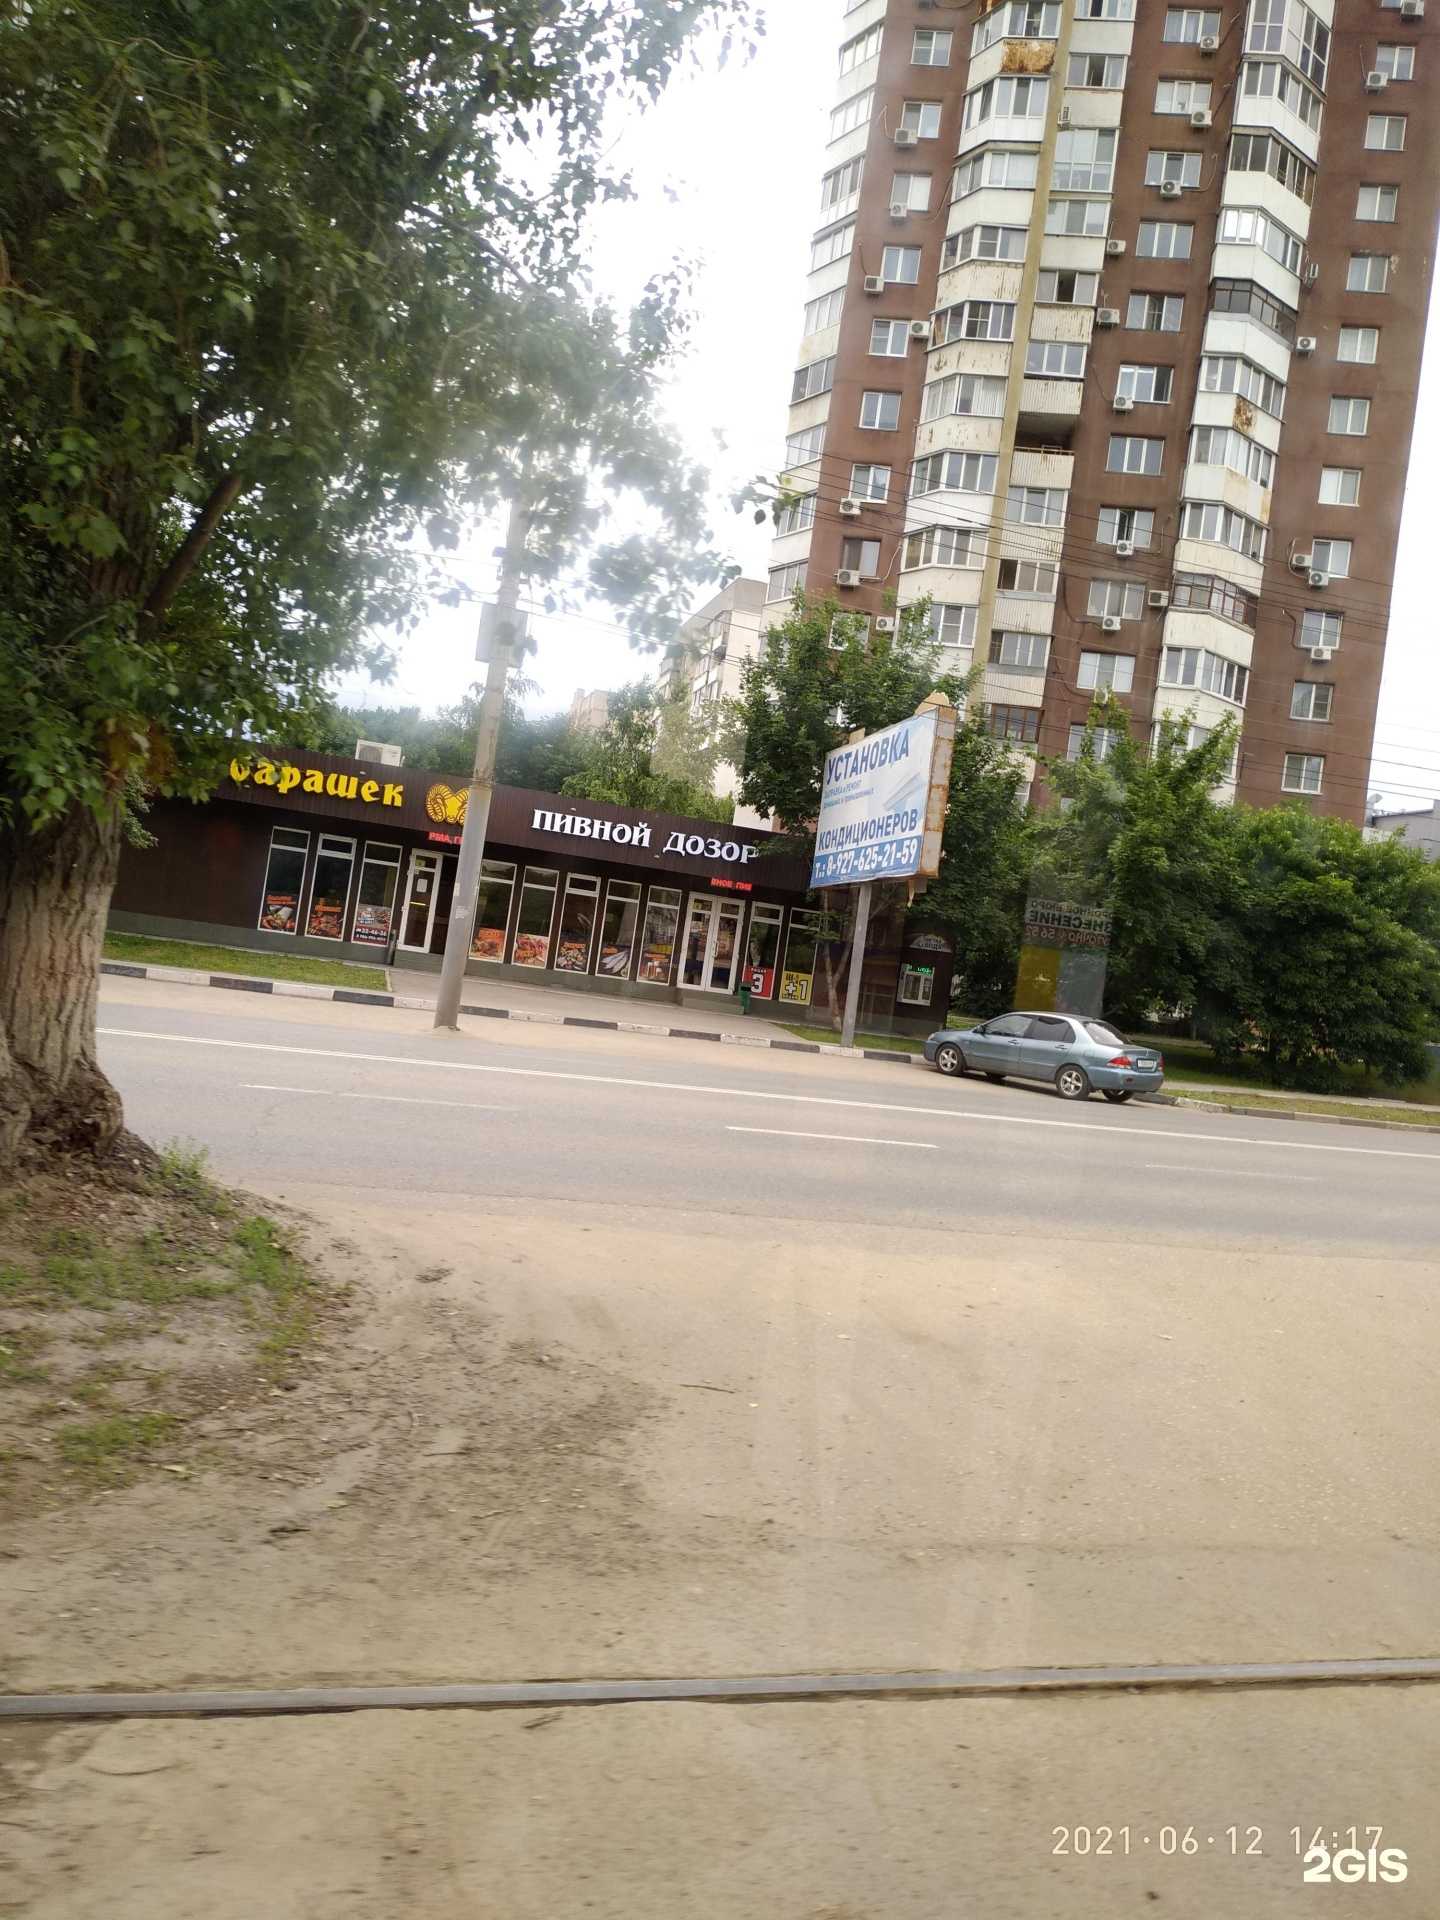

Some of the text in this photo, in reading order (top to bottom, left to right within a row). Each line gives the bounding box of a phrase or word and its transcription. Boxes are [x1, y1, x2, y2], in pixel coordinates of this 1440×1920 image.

[826, 728, 910, 785] УСТАНОВКА
[531, 808, 761, 864] ПИВНОЙ ДОЗОР
[818, 808, 919, 851] КОНДИЦИОНЕРОВ
[826, 839, 919, 877] 8-927-625-21-59
